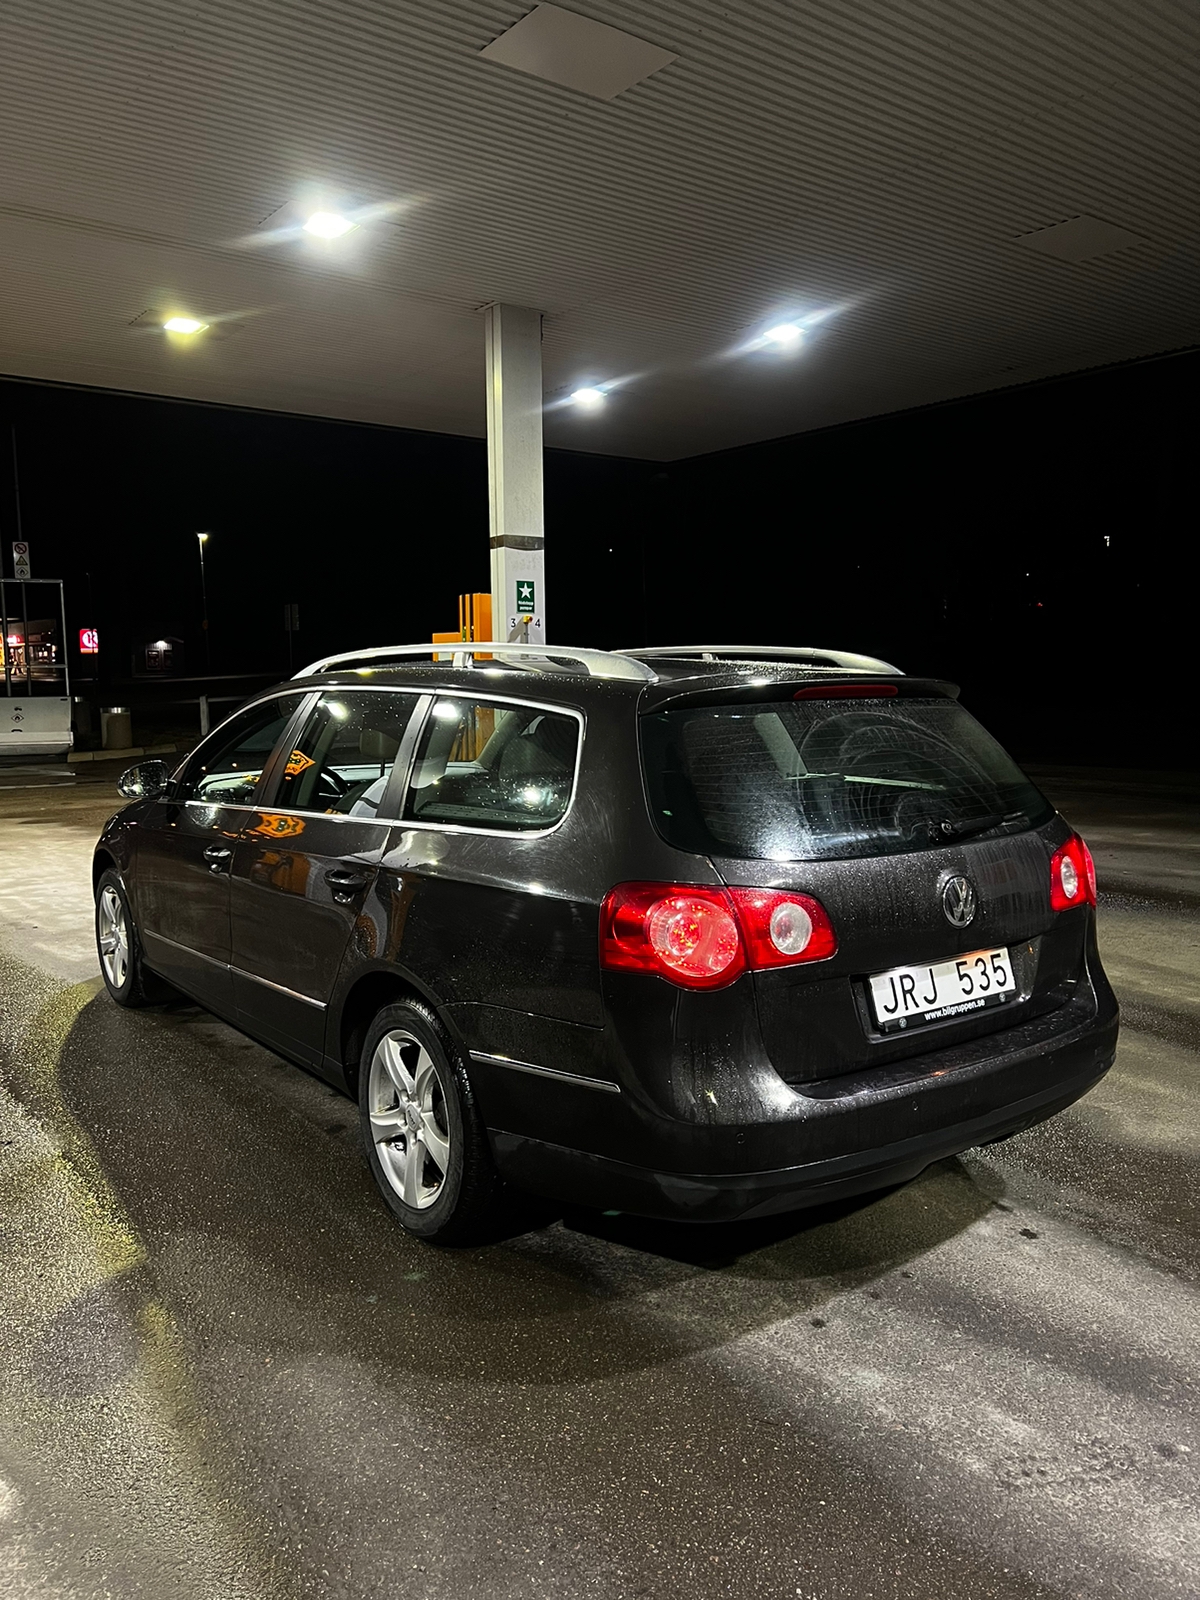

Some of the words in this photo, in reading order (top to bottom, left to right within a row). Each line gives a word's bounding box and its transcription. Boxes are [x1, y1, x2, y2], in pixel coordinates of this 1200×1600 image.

[511, 618, 516, 628] 3
[535, 619, 541, 628] 4
[883, 968, 938, 1013] JRJ
[955, 953, 1007, 995] 535
[924, 999, 985, 1020] www.bilgruppen.se
